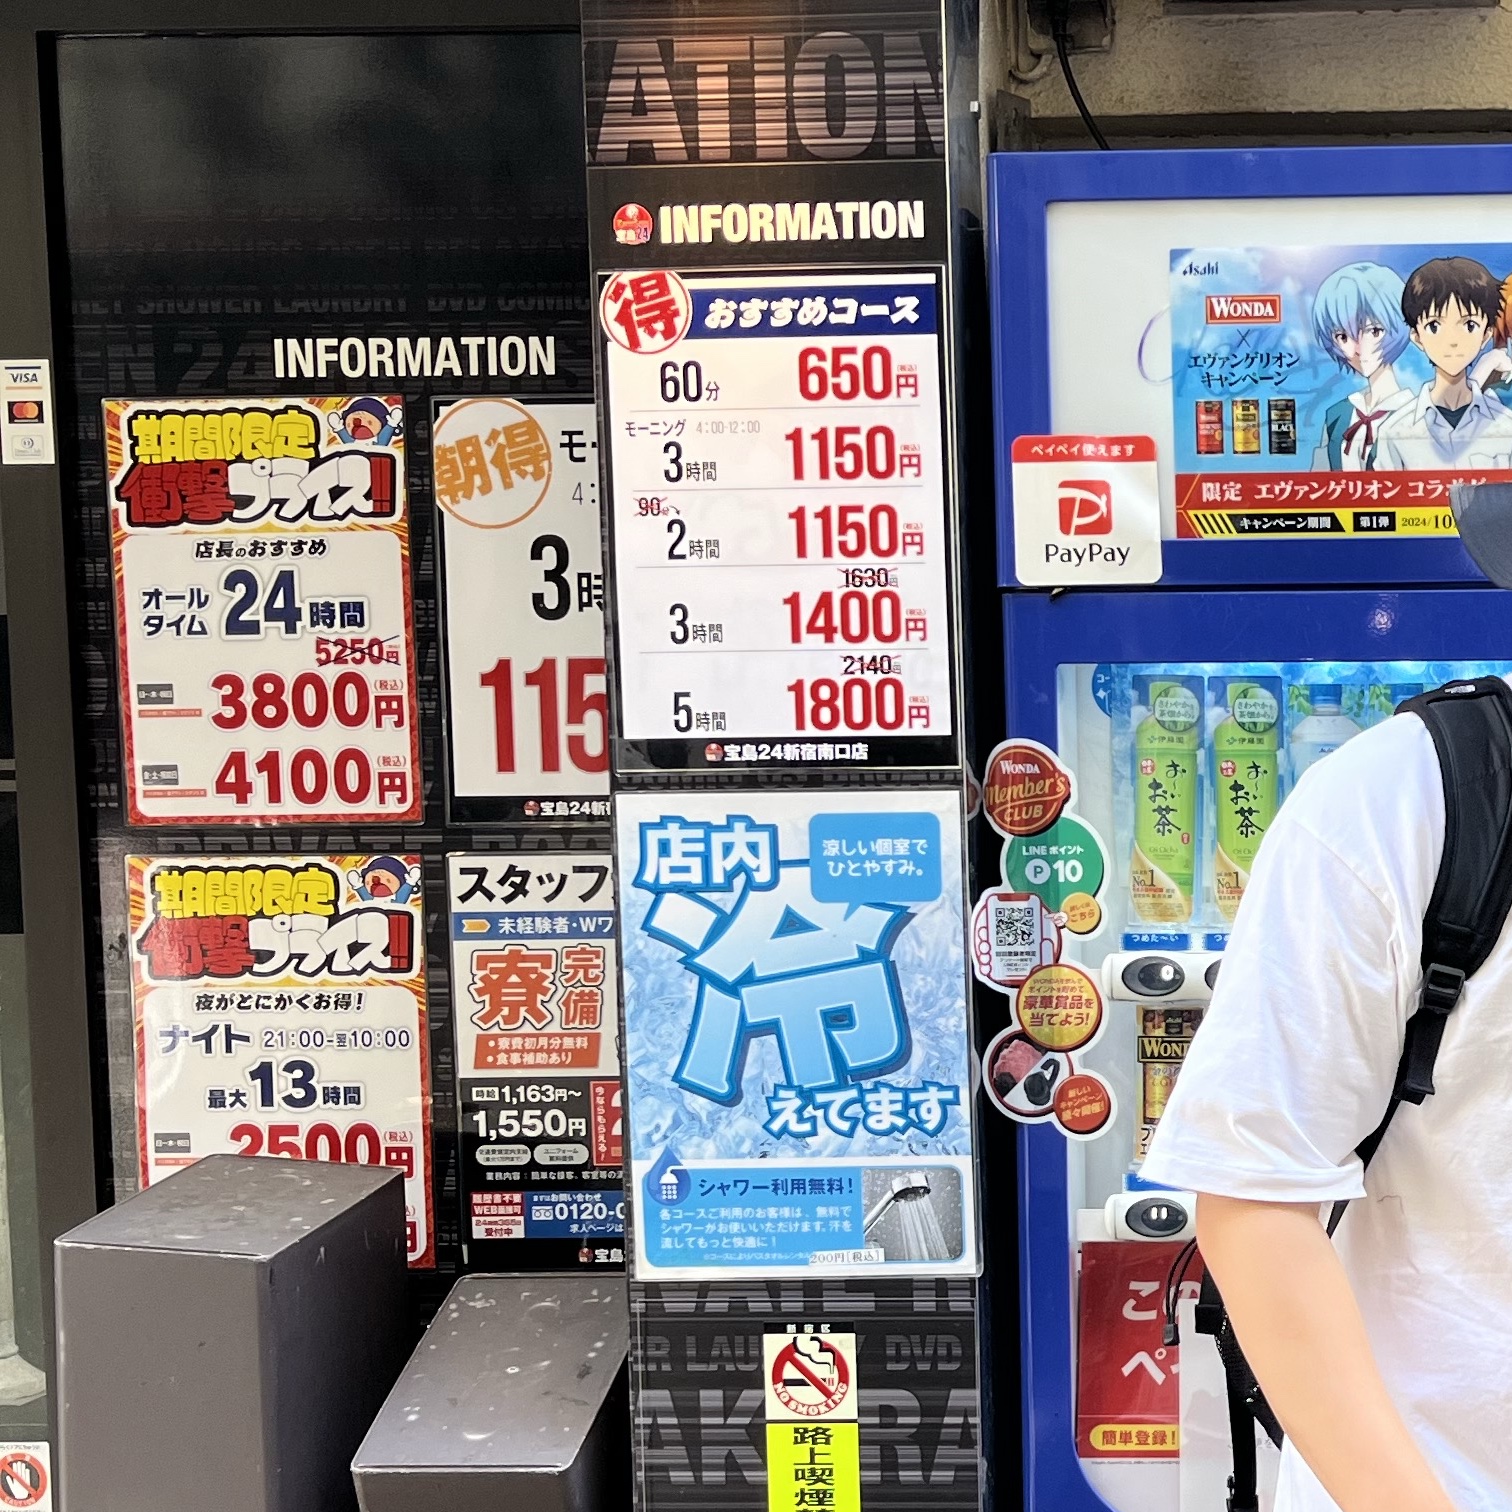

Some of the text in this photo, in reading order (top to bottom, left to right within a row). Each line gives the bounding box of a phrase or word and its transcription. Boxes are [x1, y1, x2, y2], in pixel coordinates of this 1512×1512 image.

[659, 201, 925, 244] INFORMATION
[1182, 261, 1219, 277] Asahi
[607, 271, 921, 351] 得 おすすめコース
[1210, 297, 1275, 318] WONDA
[274, 336, 556, 379] INFORMATION
[1188, 352, 1300, 369] エヴァンゲリオン
[10, 373, 38, 383] VISA
[659, 345, 919, 403] 60分 650円
[1200, 371, 1288, 388] キャンペーン
[132, 409, 316, 464] 期間限定
[625, 420, 687, 437] モーニング
[663, 425, 923, 483] 3時間 1150円
[1031, 444, 1136, 457] ペイペイ使えます
[435, 418, 552, 506] 朝得
[1201, 480, 1402, 503] 限定 エヴァンゲリオン
[667, 504, 924, 560] 2時間 1150円
[1239, 516, 1390, 530] キャンペーン期間 第1弾
[195, 539, 328, 558] 店長のおすすめ
[1045, 543, 1131, 567] PayPay
[142, 588, 209, 610] オール
[224, 568, 365, 636] 24時間
[143, 615, 208, 636] タイム
[669, 590, 928, 645] 3時間 1400円
[315, 635, 400, 666] 5250円
[374, 679, 404, 691] (税込)
[211, 671, 405, 729] 3800円
[673, 677, 930, 733] 5時間 1800円
[377, 756, 406, 768] (税込)
[723, 743, 869, 762] 宝島24新宿南口店
[215, 747, 407, 806] 4100円
[1000, 760, 1041, 774] WONDA
[986, 773, 1066, 806] Member's
[1003, 804, 1043, 823] CLUB
[638, 818, 776, 889] 店内
[822, 838, 929, 857] 涼しい個室で
[1022, 845, 1085, 856] LINE ポイント
[827, 859, 925, 877] ひとやすみ。
[1052, 859, 1084, 883] 10
[155, 867, 335, 918] 期間限定
[457, 863, 609, 905] スタッフ
[1069, 909, 1096, 922] こちら
[472, 945, 604, 1028] 寮 完備
[645, 875, 907, 1101] 冷
[195, 992, 365, 1011] 夜がとにかくお得!
[1022, 995, 1095, 1010] 豪華賞品を
[1028, 1012, 1090, 1027] 当てよう!
[159, 1024, 251, 1055] ナイト
[497, 1037, 589, 1050] 寮費初月分無料
[495, 1052, 573, 1066] 食事補助あり
[207, 1060, 362, 1109] 最大13時間
[766, 1083, 957, 1136] えてます
[472, 1109, 587, 1141] 1,550円
[698, 1177, 854, 1198] シャワー利用無料!
[659, 1205, 852, 1222] 各コースご利用のお客様は、無料で
[484, 1227, 513, 1237] 受付中
[660, 1234, 778, 1250] 流してもっと快適に!
[774, 1382, 849, 1417] NO SMOKING
[1101, 1429, 1176, 1446] 簡単登録!
